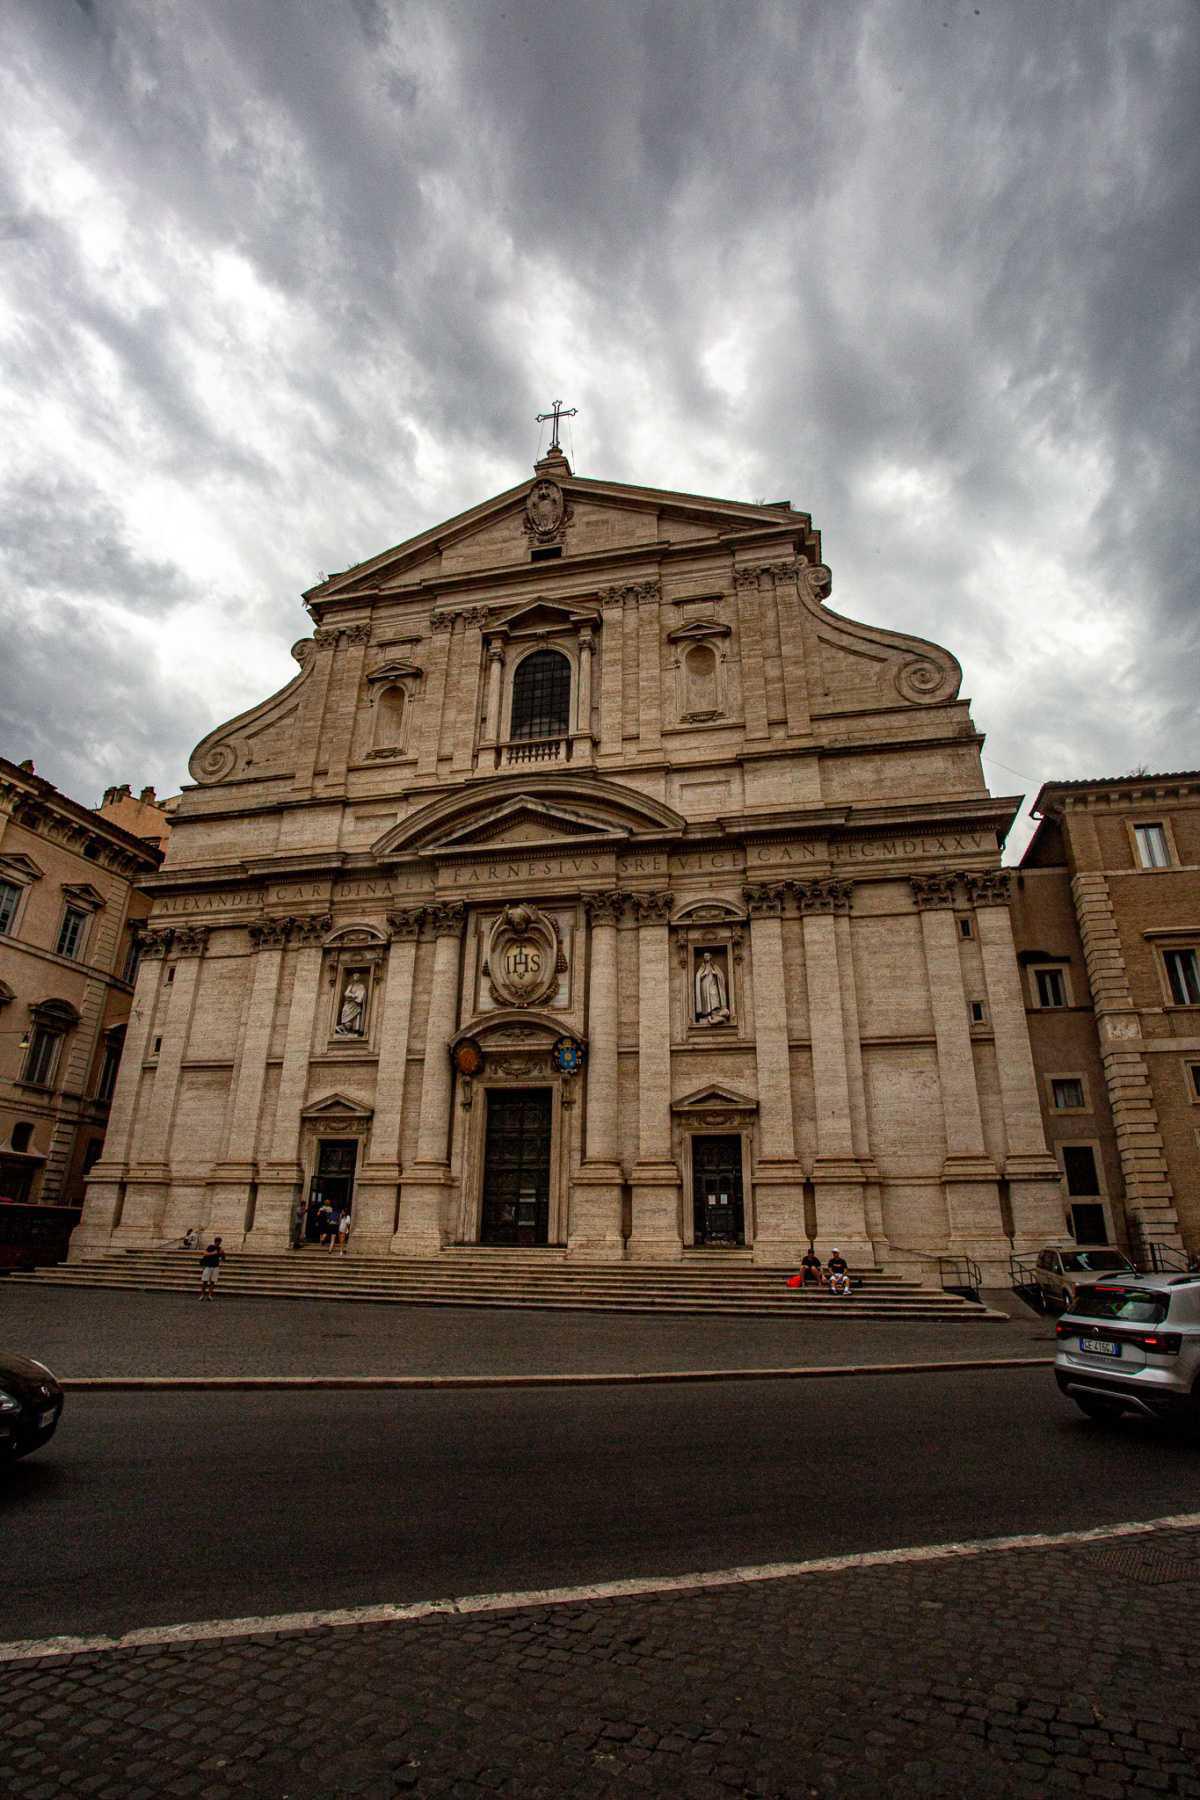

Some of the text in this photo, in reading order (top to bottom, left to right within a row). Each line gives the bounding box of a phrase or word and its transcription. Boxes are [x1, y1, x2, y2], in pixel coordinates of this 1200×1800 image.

[160, 893, 264, 911] ALEXANDER
[453, 859, 600, 882] FARNESIVS
[506, 954, 540, 974] IHS
